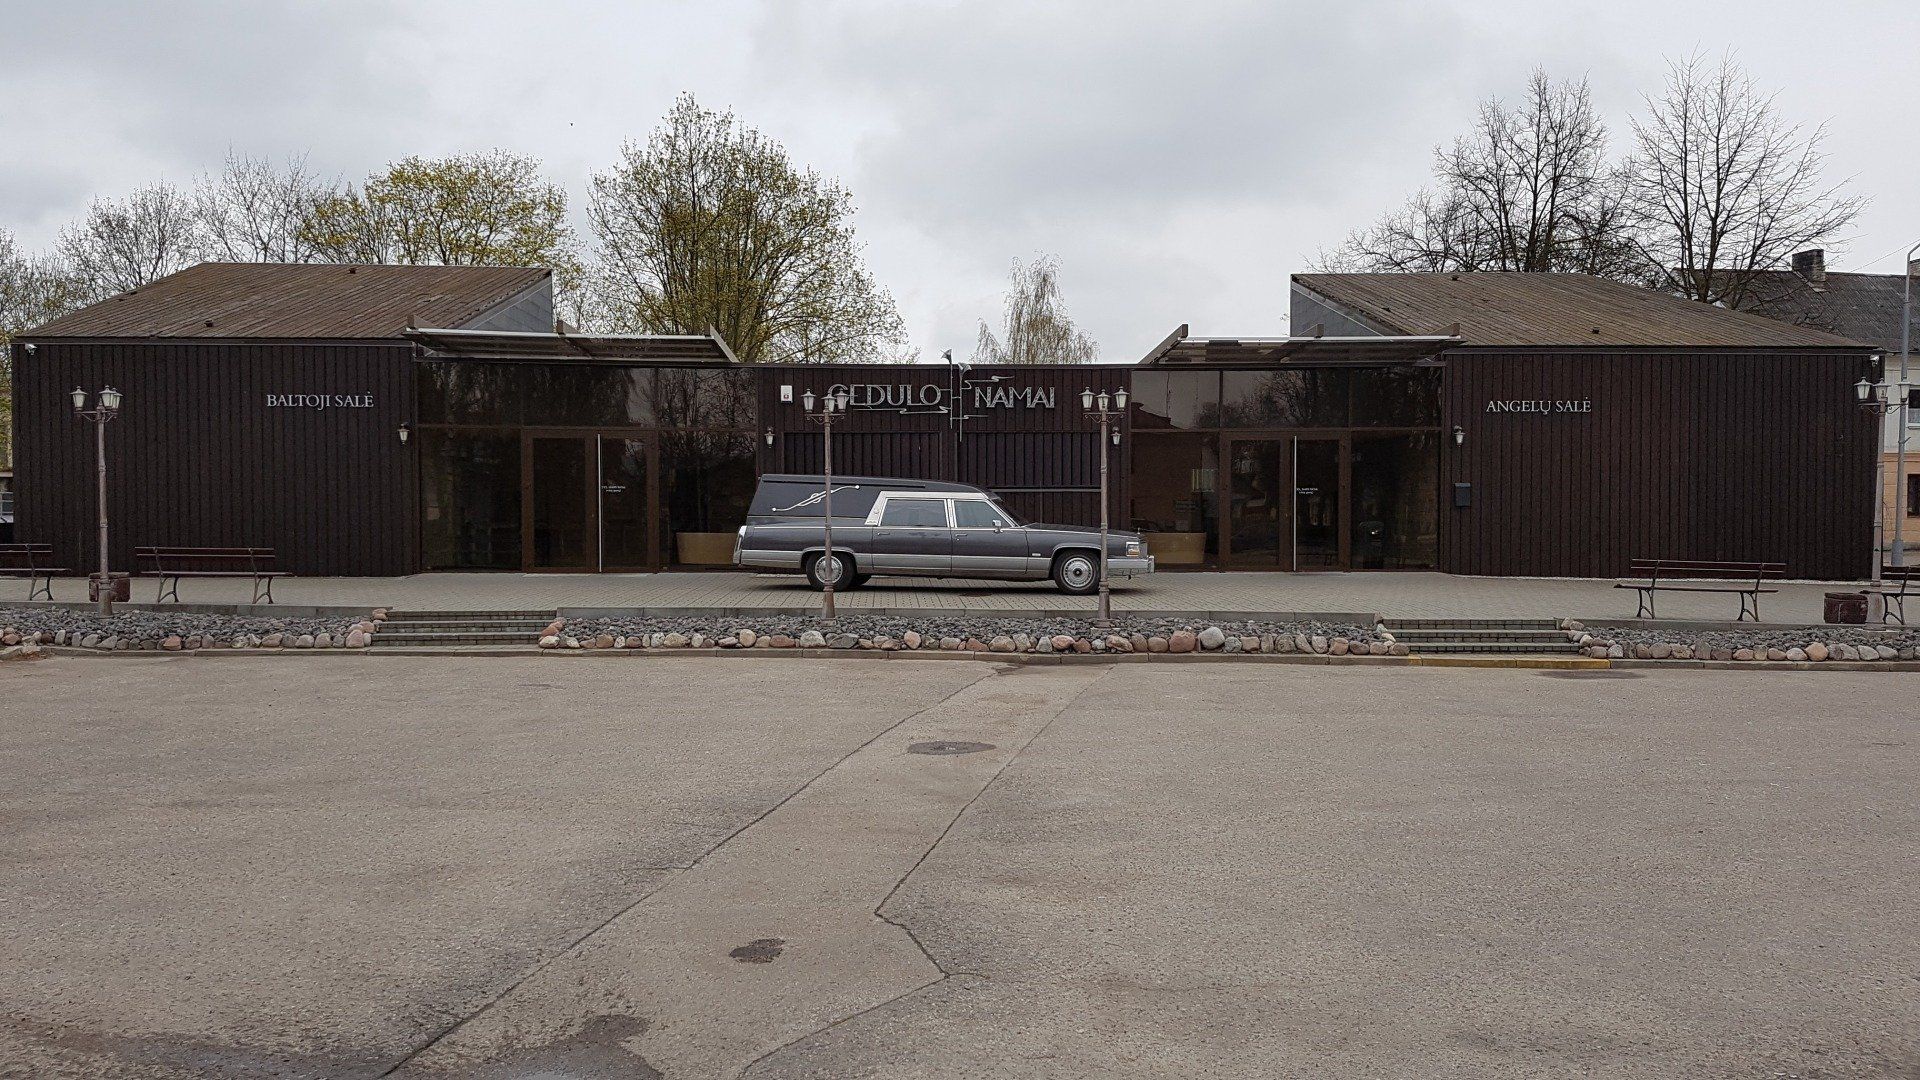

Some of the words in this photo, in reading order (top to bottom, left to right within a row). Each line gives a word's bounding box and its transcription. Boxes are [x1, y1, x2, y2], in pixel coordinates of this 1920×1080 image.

[266, 394, 330, 411] BALTOJI
[334, 391, 374, 408] SALĖ
[974, 386, 1056, 408] NAMAI
[1486, 400, 1551, 415] ANGELŲ
[1555, 396, 1592, 413] SALĖ
